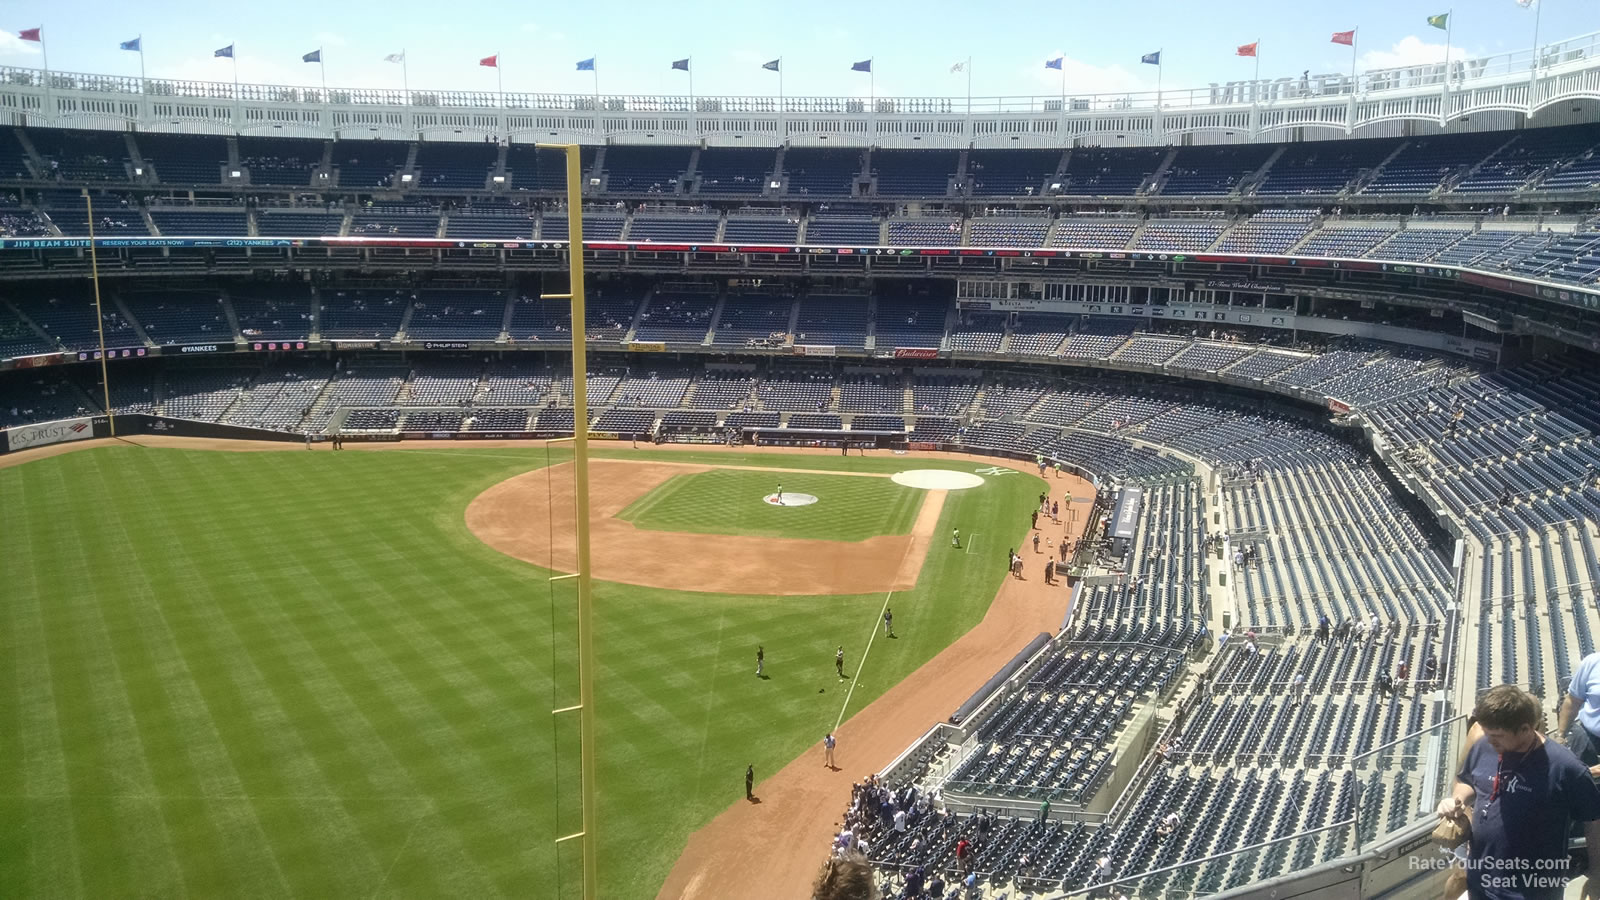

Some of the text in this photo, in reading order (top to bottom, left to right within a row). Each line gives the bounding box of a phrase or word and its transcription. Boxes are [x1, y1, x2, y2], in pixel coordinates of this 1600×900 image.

[181, 345, 217, 353] @YANKEES
[11, 426, 67, 445] U.S. TRUST
